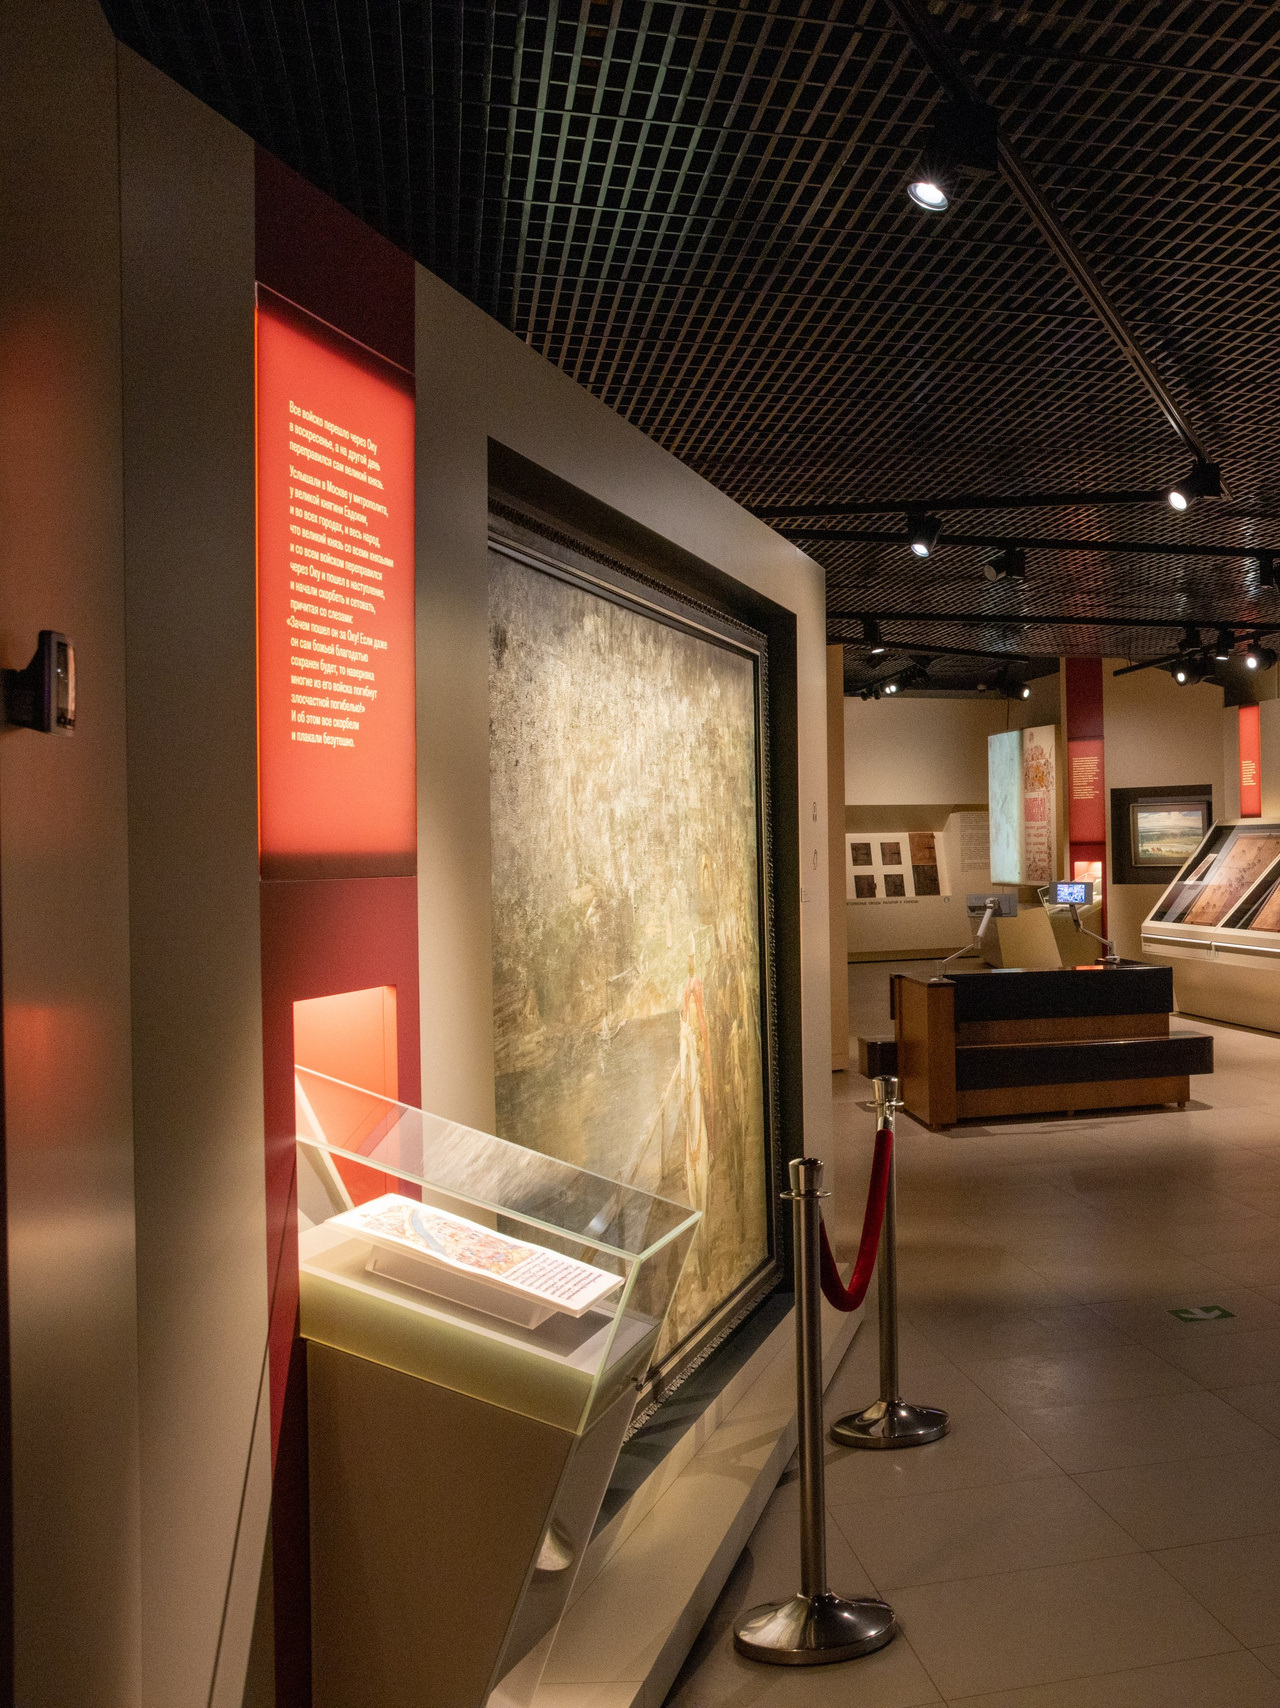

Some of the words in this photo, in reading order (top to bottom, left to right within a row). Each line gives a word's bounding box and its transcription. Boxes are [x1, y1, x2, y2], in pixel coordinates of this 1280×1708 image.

[290, 400, 301, 416] Все
[302, 410, 323, 427] войско
[324, 420, 349, 439] перешло
[350, 433, 366, 447] через
[367, 439, 377, 455] Оку
[340, 446, 347, 456] на
[348, 450, 367, 465] другой
[368, 459, 380, 471] день
[290, 465, 321, 488] Услышали
[327, 480, 348, 499] Москве
[333, 460, 344, 472] сам
[345, 466, 367, 482] великий
[295, 489, 319, 506] великой
[321, 499, 343, 514] княгини
[295, 507, 303, 518] во
[304, 511, 318, 523] всех
[350, 528, 362, 539] весь
[290, 525, 301, 536] что
[302, 528, 326, 544] великий
[327, 537, 344, 550] князь
[345, 544, 351, 553] со
[352, 546, 369, 559] всеми
[296, 545, 303, 555] со
[304, 548, 319, 560] всем
[320, 553, 344, 568] войском
[290, 562, 308, 576] через
[309, 565, 320, 582] Оку
[327, 573, 345, 586] пошел
[296, 582, 317, 596] начали
[319, 589, 345, 604] скорбеть
[290, 600, 318, 615] причитая
[320, 607, 327, 617] со
[311, 623, 330, 636] пошел
[331, 628, 338, 638] он
[339, 631, 346, 640] за
[360, 633, 373, 646] Если
[374, 639, 387, 649] даже
[291, 637, 298, 647] он
[300, 639, 311, 650] сам
[313, 639, 334, 655] божьей
[336, 644, 368, 662] благодатью
[339, 666, 345, 675] то
[347, 668, 374, 681] наверняка
[291, 675, 313, 687] многие
[314, 680, 321, 688] из
[322, 681, 332, 690] его
[333, 681, 352, 694] войска
[354, 686, 377, 700] погибнут
[291, 694, 329, 708] злосчастной
[297, 711, 305, 723] об
[306, 715, 320, 725] этом
[322, 717, 332, 726] все
[333, 717, 359, 731] скорбели
[297, 732, 322, 743] плакали
